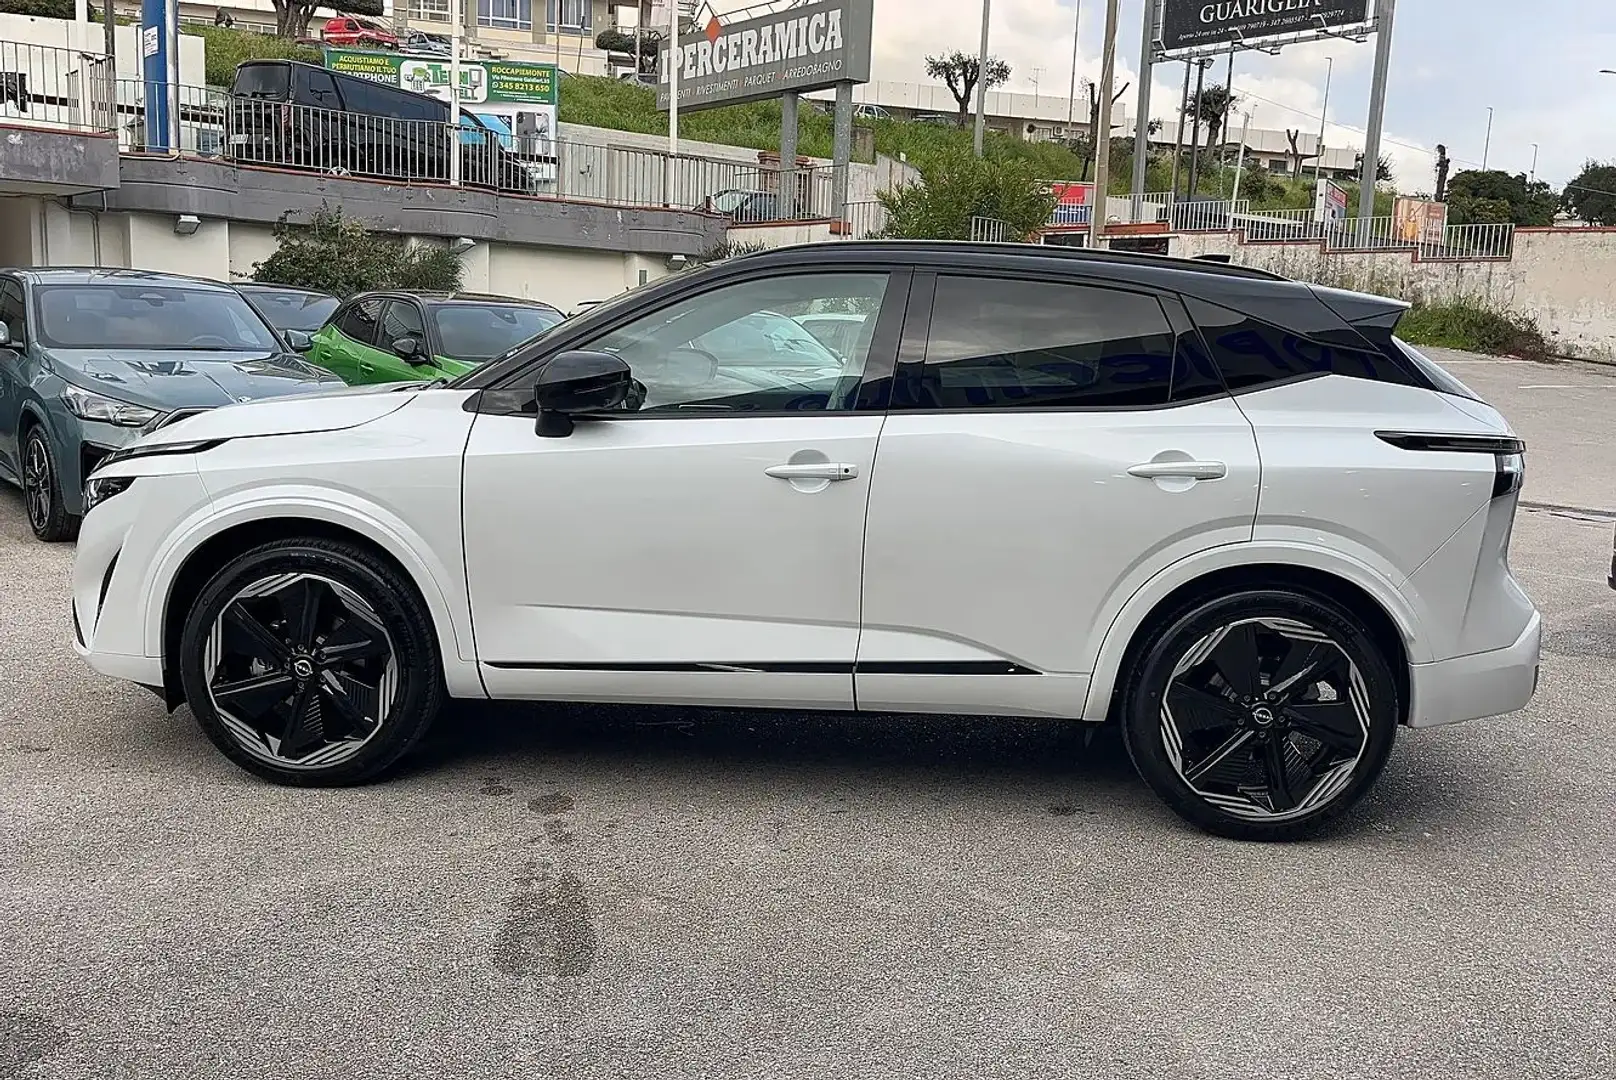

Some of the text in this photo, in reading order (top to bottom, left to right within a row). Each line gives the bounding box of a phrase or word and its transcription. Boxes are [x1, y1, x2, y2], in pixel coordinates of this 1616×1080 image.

[1199, 0, 1322, 23] GUARIGL
[660, 8, 844, 84] IPERCERAMICA
[339, 55, 384, 65] ACQUISTIAMO
[332, 62, 376, 72] PERMUTIAMO
[382, 66, 397, 74] TUO
[491, 66, 551, 78] ROCCAPIEMONTE
[744, 71, 776, 87] PARQUET
[782, 59, 843, 80] ARREDOBAGNO
[499, 81, 550, 92] 345 8213 650
